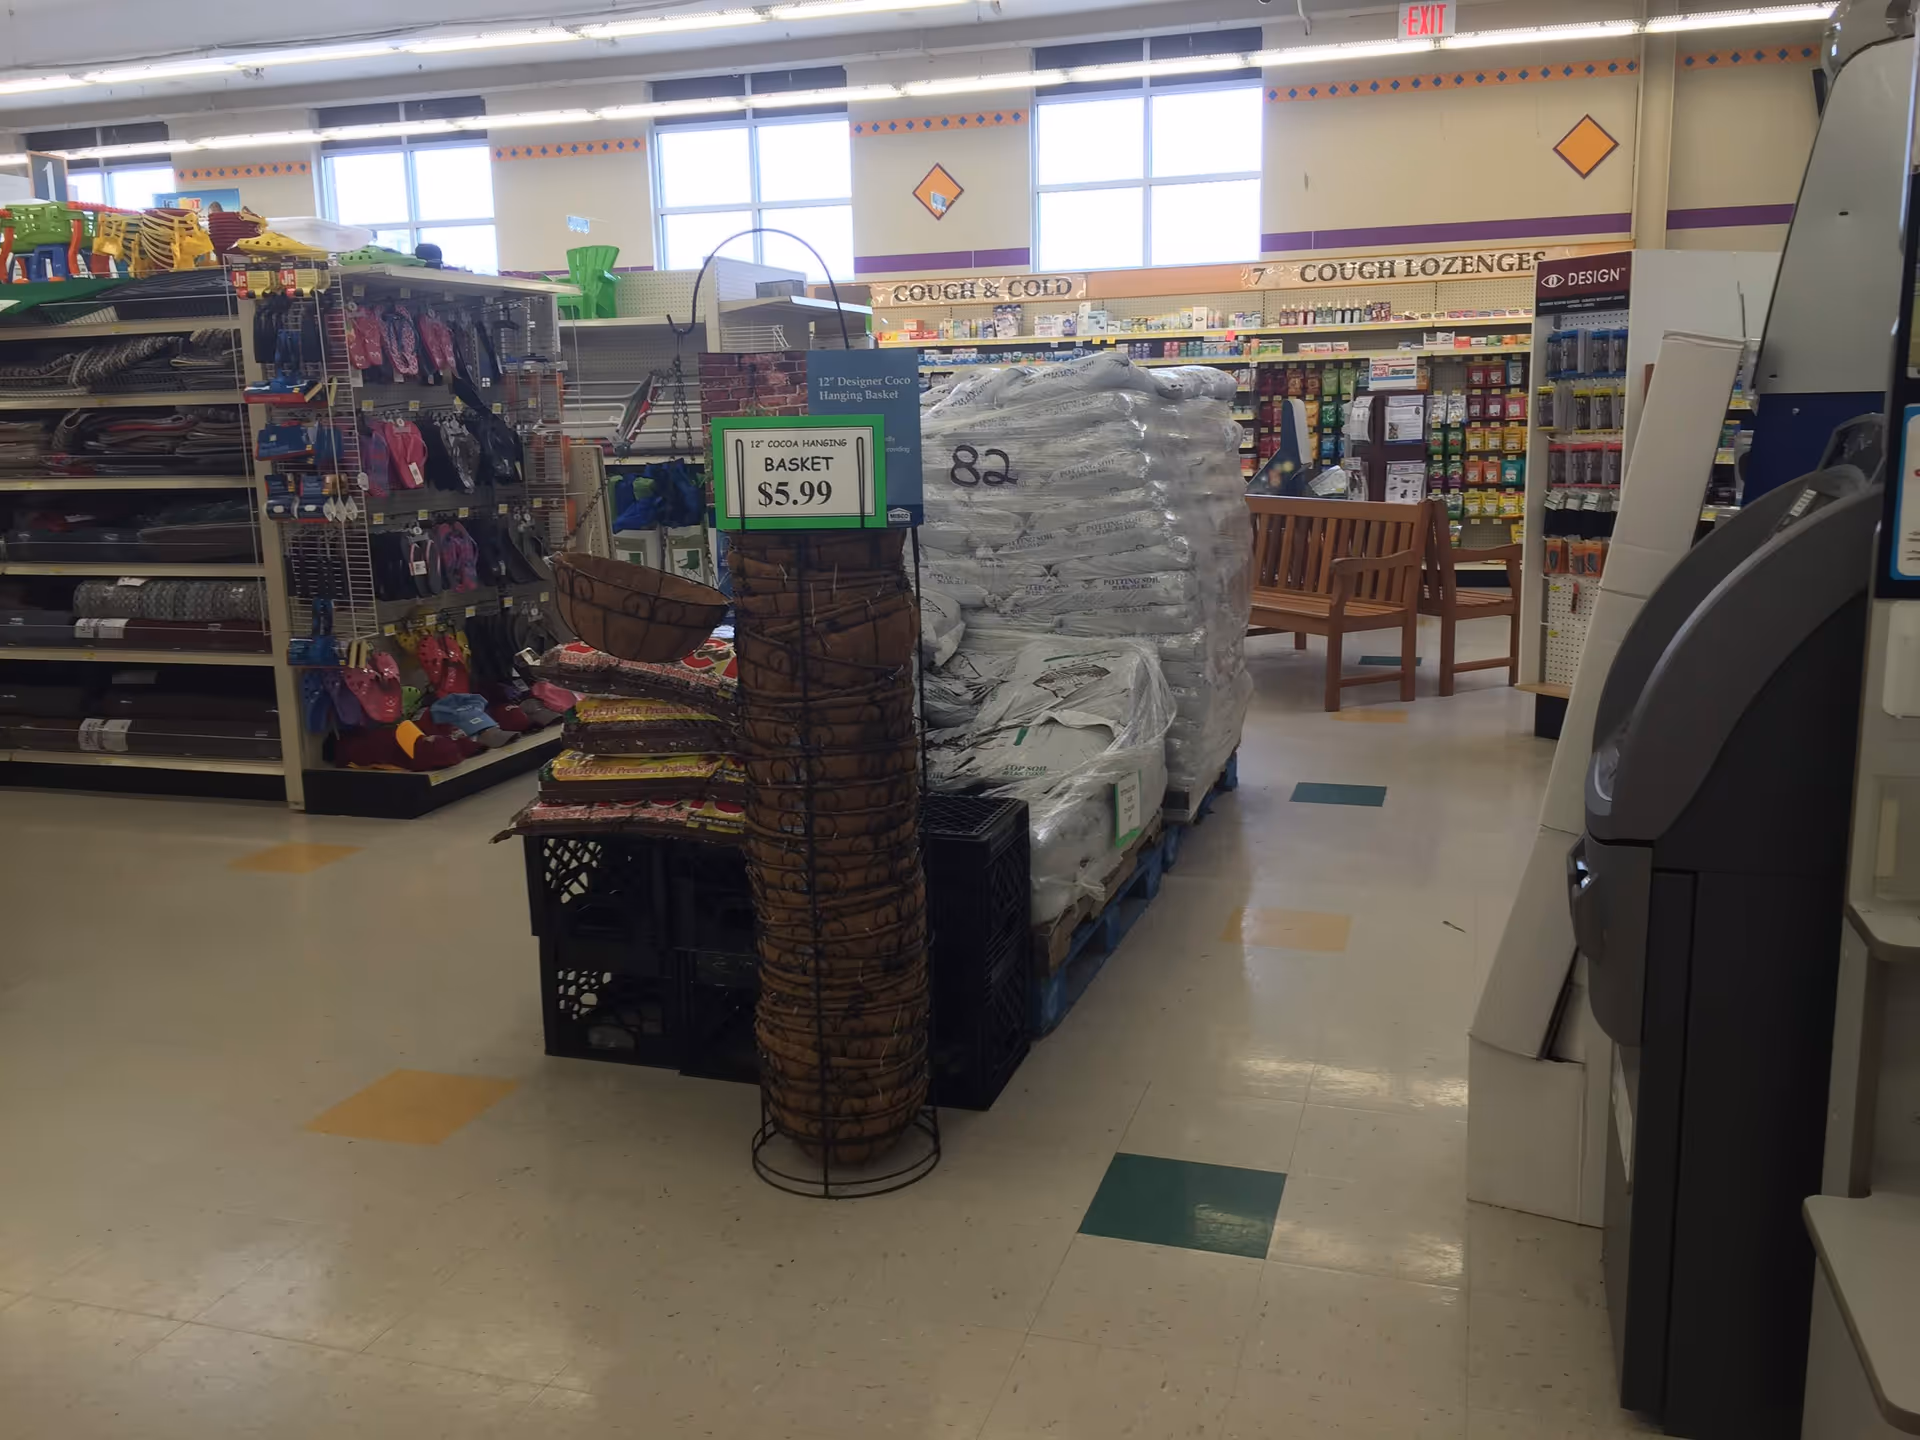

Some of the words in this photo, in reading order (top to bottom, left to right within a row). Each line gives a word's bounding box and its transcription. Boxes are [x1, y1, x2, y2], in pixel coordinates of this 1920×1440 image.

[1407, 4, 1448, 36] EXIT
[41, 161, 57, 201] 1
[1252, 266, 1266, 286] 7
[1299, 258, 1396, 283] COUGH
[1404, 251, 1546, 277] LOZENGES
[1568, 267, 1620, 286] DESIGN
[893, 281, 976, 303] COUGH
[983, 283, 1000, 299] &
[1007, 278, 1073, 298] COLD
[837, 376, 882, 389] Designer
[884, 375, 911, 386] Coco
[819, 390, 862, 403] Hanging
[865, 389, 899, 400] Basket
[750, 439, 764, 449] 12"
[767, 439, 799, 449] COCOA
[802, 438, 848, 448] HANGING
[764, 456, 834, 472] BASKET
[950, 444, 1018, 487] 82
[757, 480, 833, 508] $5.99
[1086, 520, 1123, 532] POTTING
[1104, 578, 1140, 586] POTTING
[1142, 576, 1161, 584] SOIL
